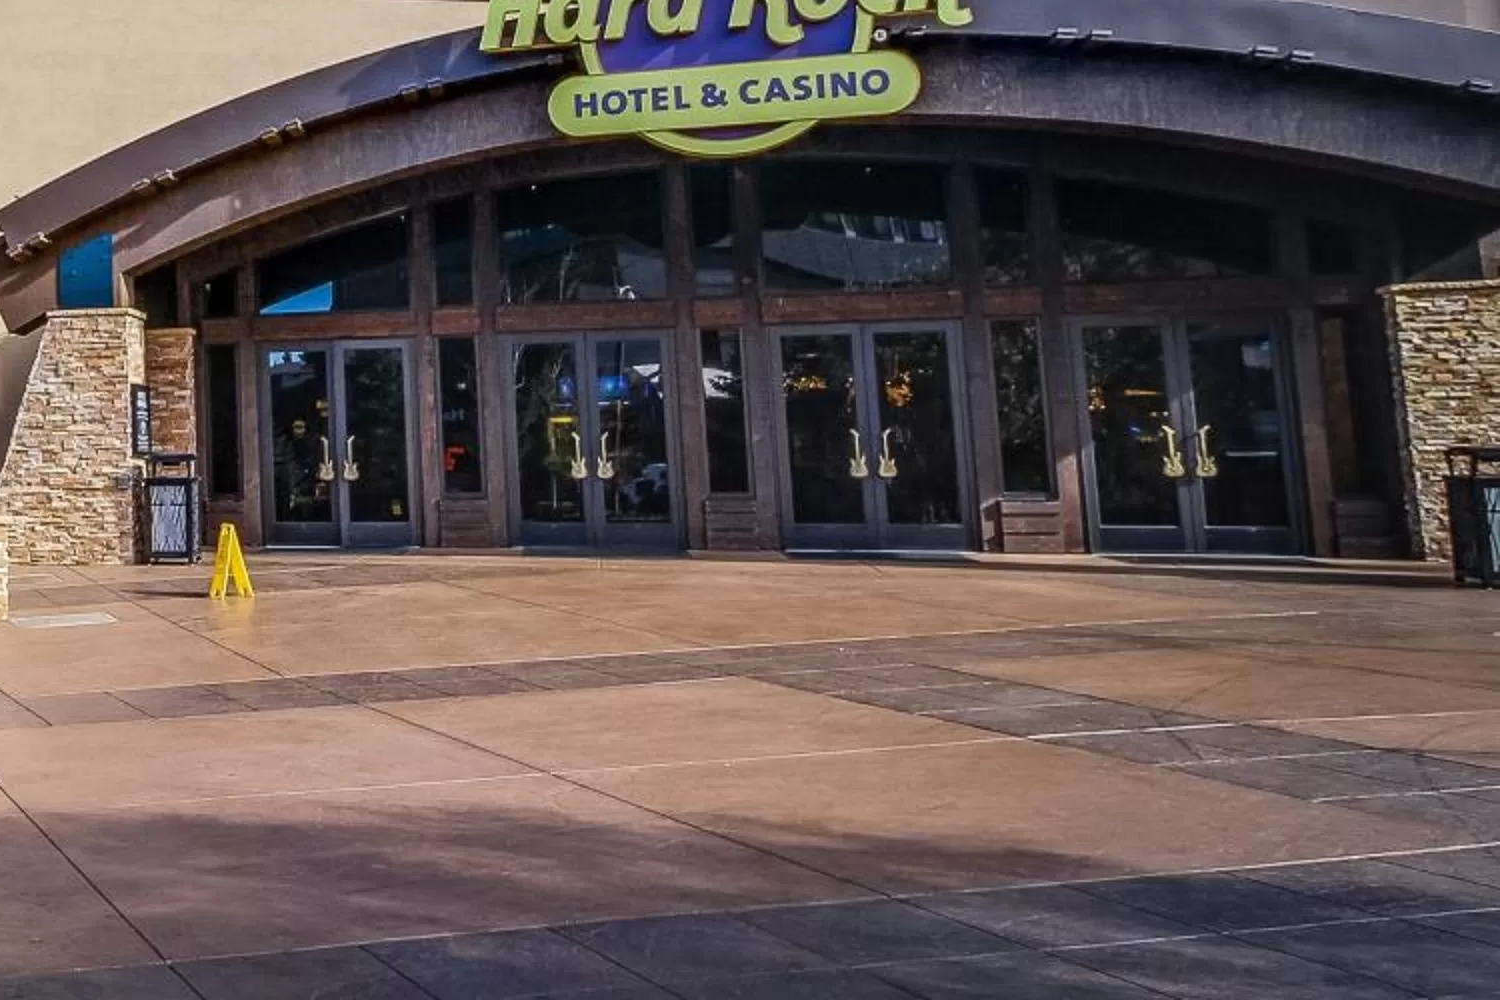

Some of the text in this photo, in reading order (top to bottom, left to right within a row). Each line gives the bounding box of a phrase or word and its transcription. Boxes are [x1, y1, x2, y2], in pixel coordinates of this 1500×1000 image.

[574, 69, 890, 118] HOTEL & CASINO
